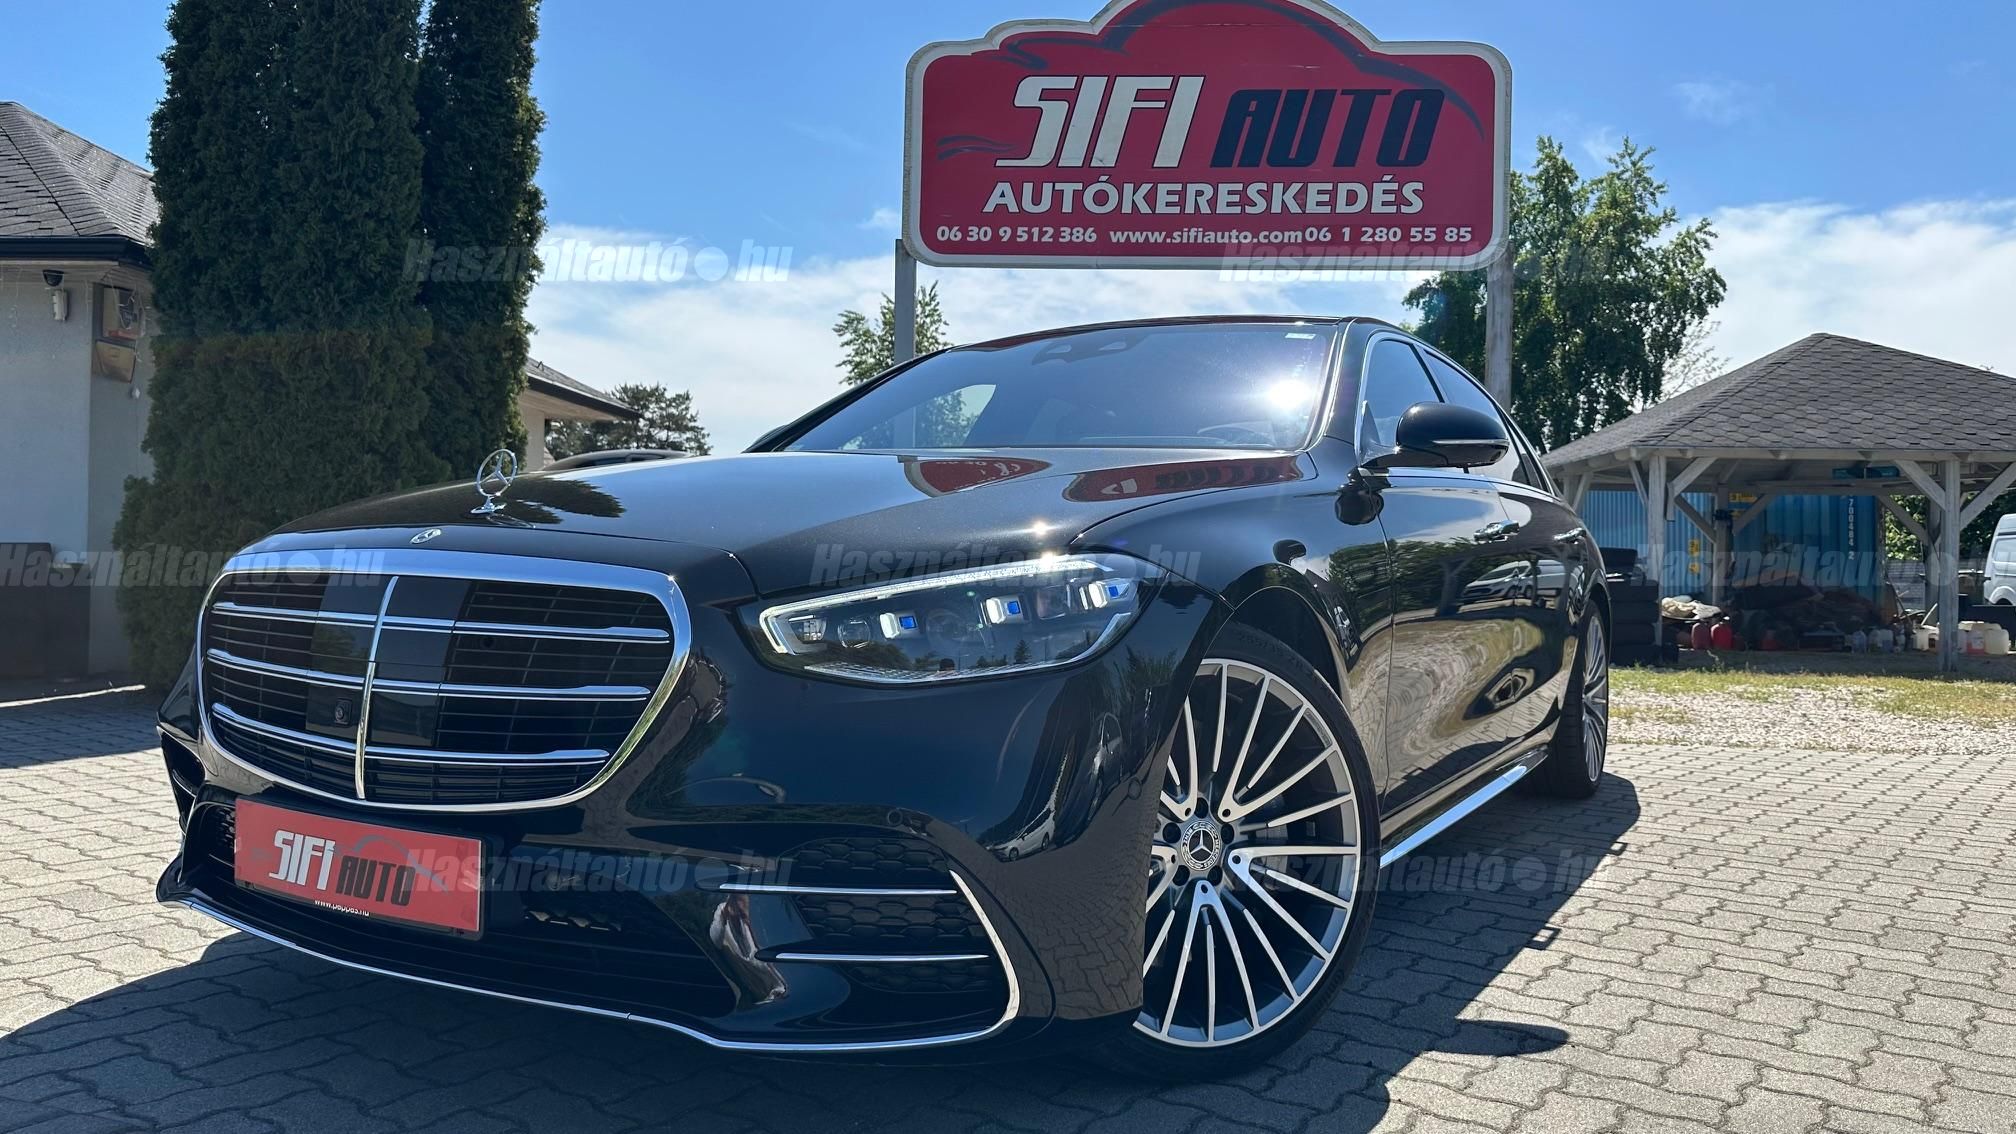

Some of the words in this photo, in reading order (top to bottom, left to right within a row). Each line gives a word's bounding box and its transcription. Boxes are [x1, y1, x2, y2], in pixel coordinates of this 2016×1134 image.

[994, 75, 1206, 168] SIFI
[1210, 88, 1446, 168] AUTO
[982, 174, 1425, 215] AUTÓKERESKEDÉS
[936, 226, 962, 243] 06
[966, 226, 992, 243] 30
[1059, 226, 1097, 243] 386
[1110, 227, 1303, 245] www.sifiauto.com
[1340, 227, 1351, 242] 1
[1361, 227, 1402, 243] 280
[1409, 227, 1437, 243] 55
[1445, 227, 1472, 243] 85
[268, 829, 336, 892] SIFI
[335, 854, 416, 907] AUTO
